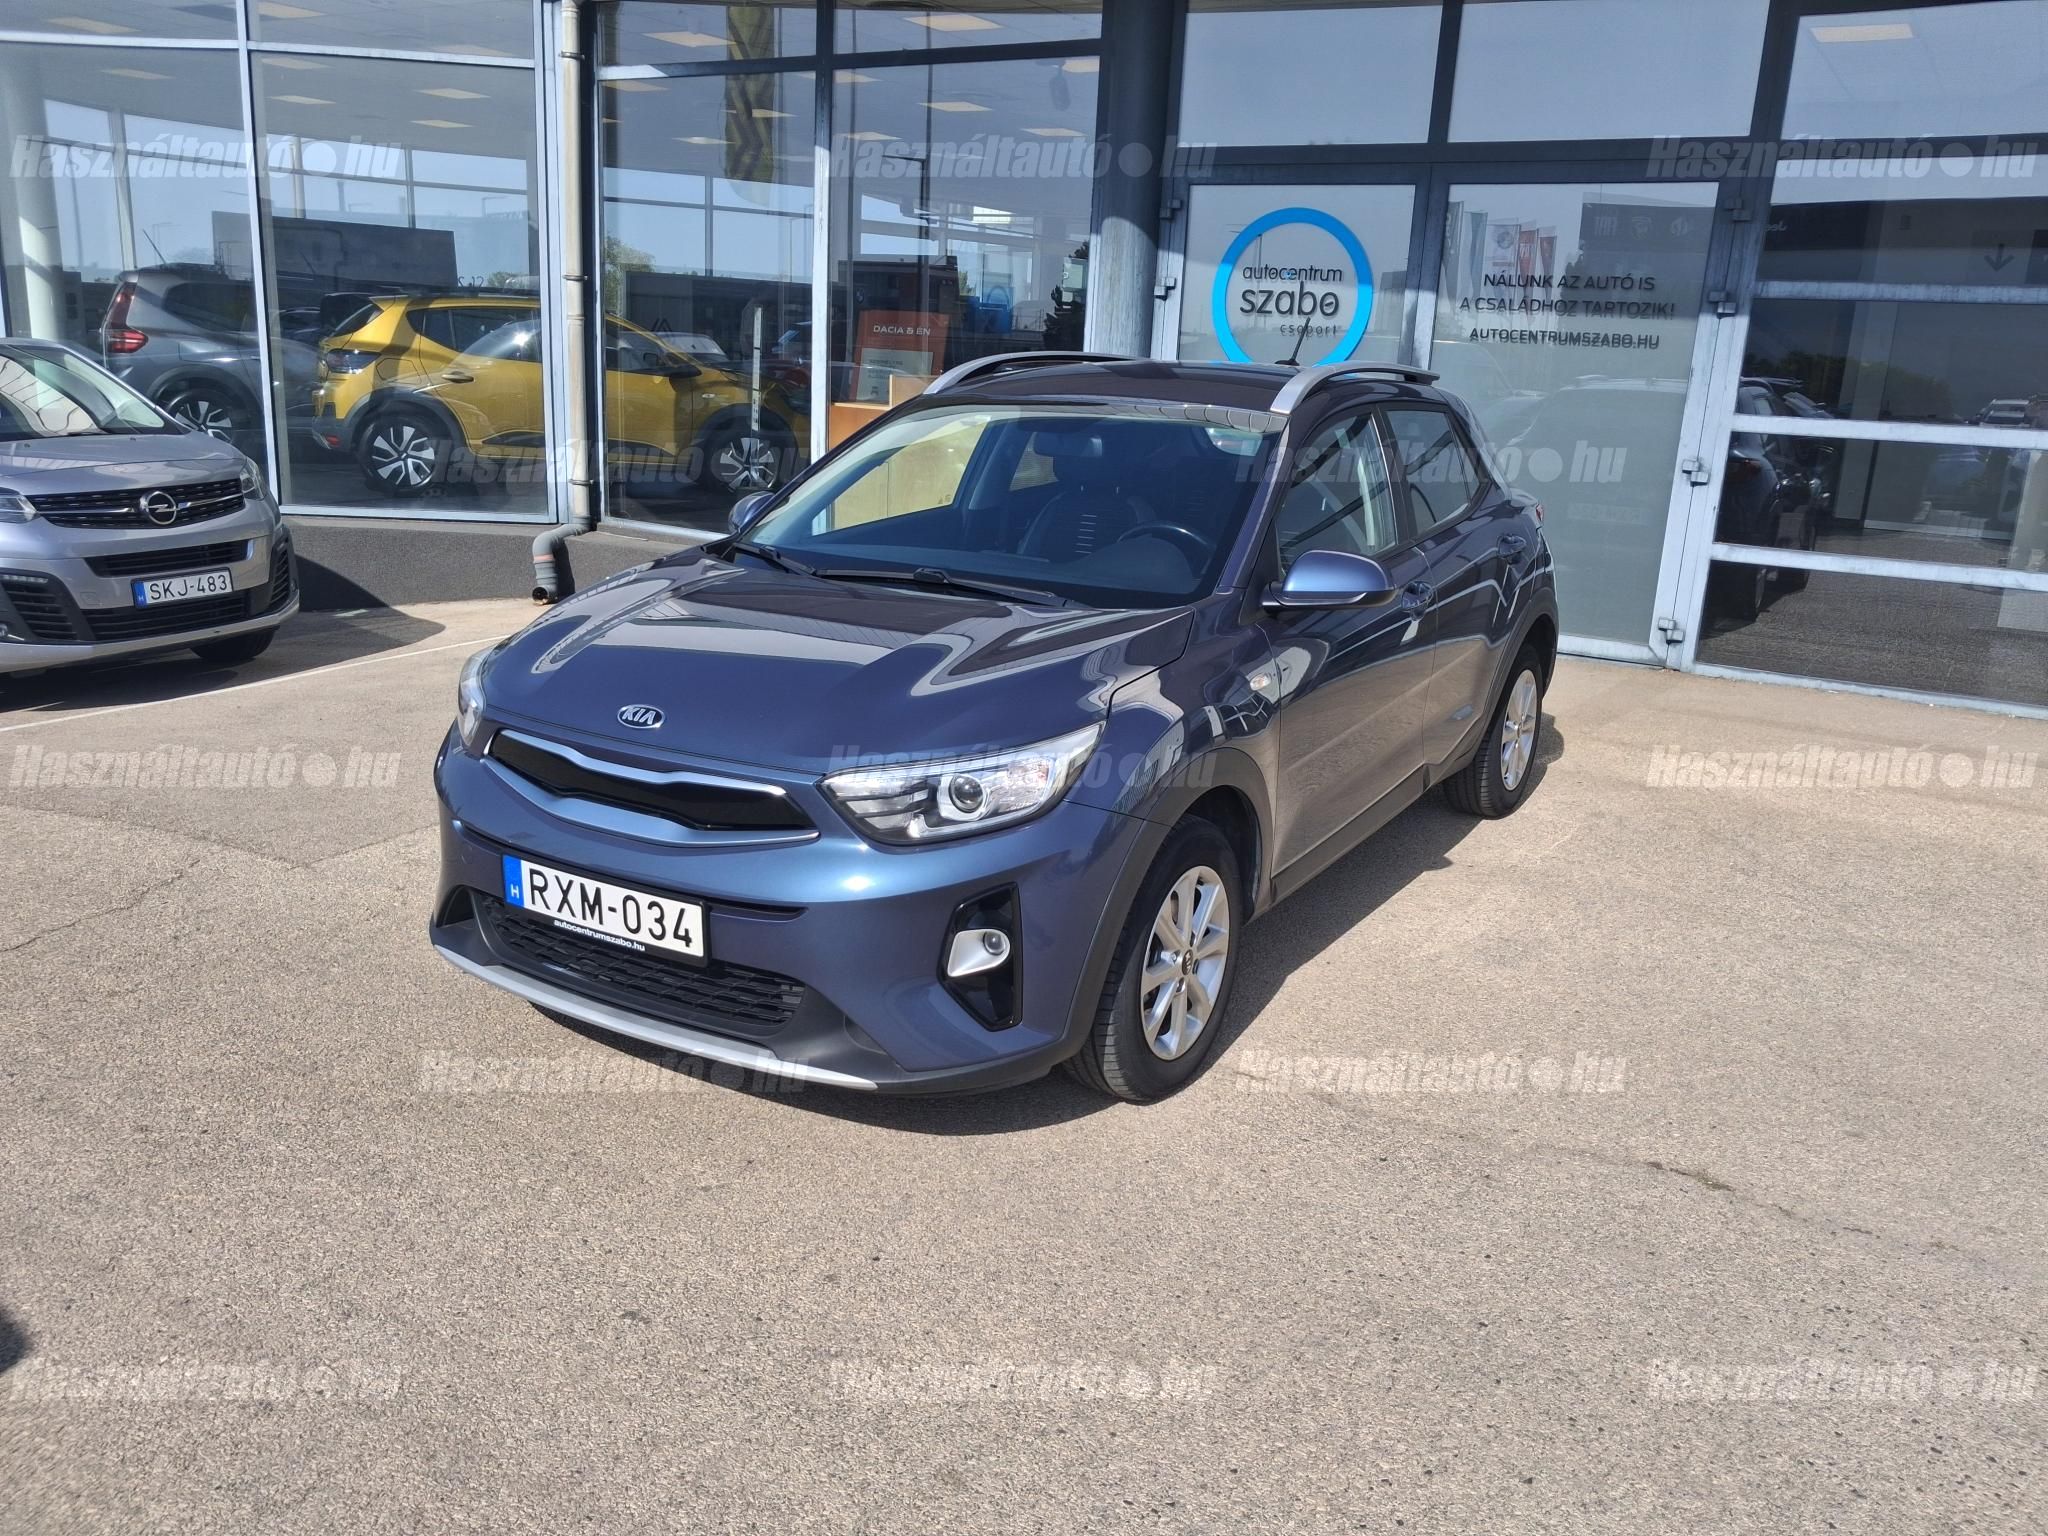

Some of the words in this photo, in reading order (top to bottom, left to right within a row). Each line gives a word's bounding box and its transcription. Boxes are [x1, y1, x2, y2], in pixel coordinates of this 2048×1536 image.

[1484, 270, 1553, 289] NÁLUNK
[1557, 275, 1581, 289] AZ
[1584, 272, 1634, 290] AUTÓ
[1638, 276, 1656, 290] IS
[1459, 297, 1471, 310] A
[1474, 296, 1577, 315] CSALÁDHOZ
[1582, 300, 1675, 317] TARTOZIK!
[873, 325, 904, 335] DACIA
[916, 327, 931, 336] EN
[1469, 327, 1660, 349] AUTOCENTRUMSZABO.HU
[149, 574, 228, 601] SKJ-483
[621, 706, 657, 725] KIA
[510, 884, 520, 899] H
[528, 867, 693, 948] RXM-034
[553, 918, 646, 951] autocentrumszabo.hu
